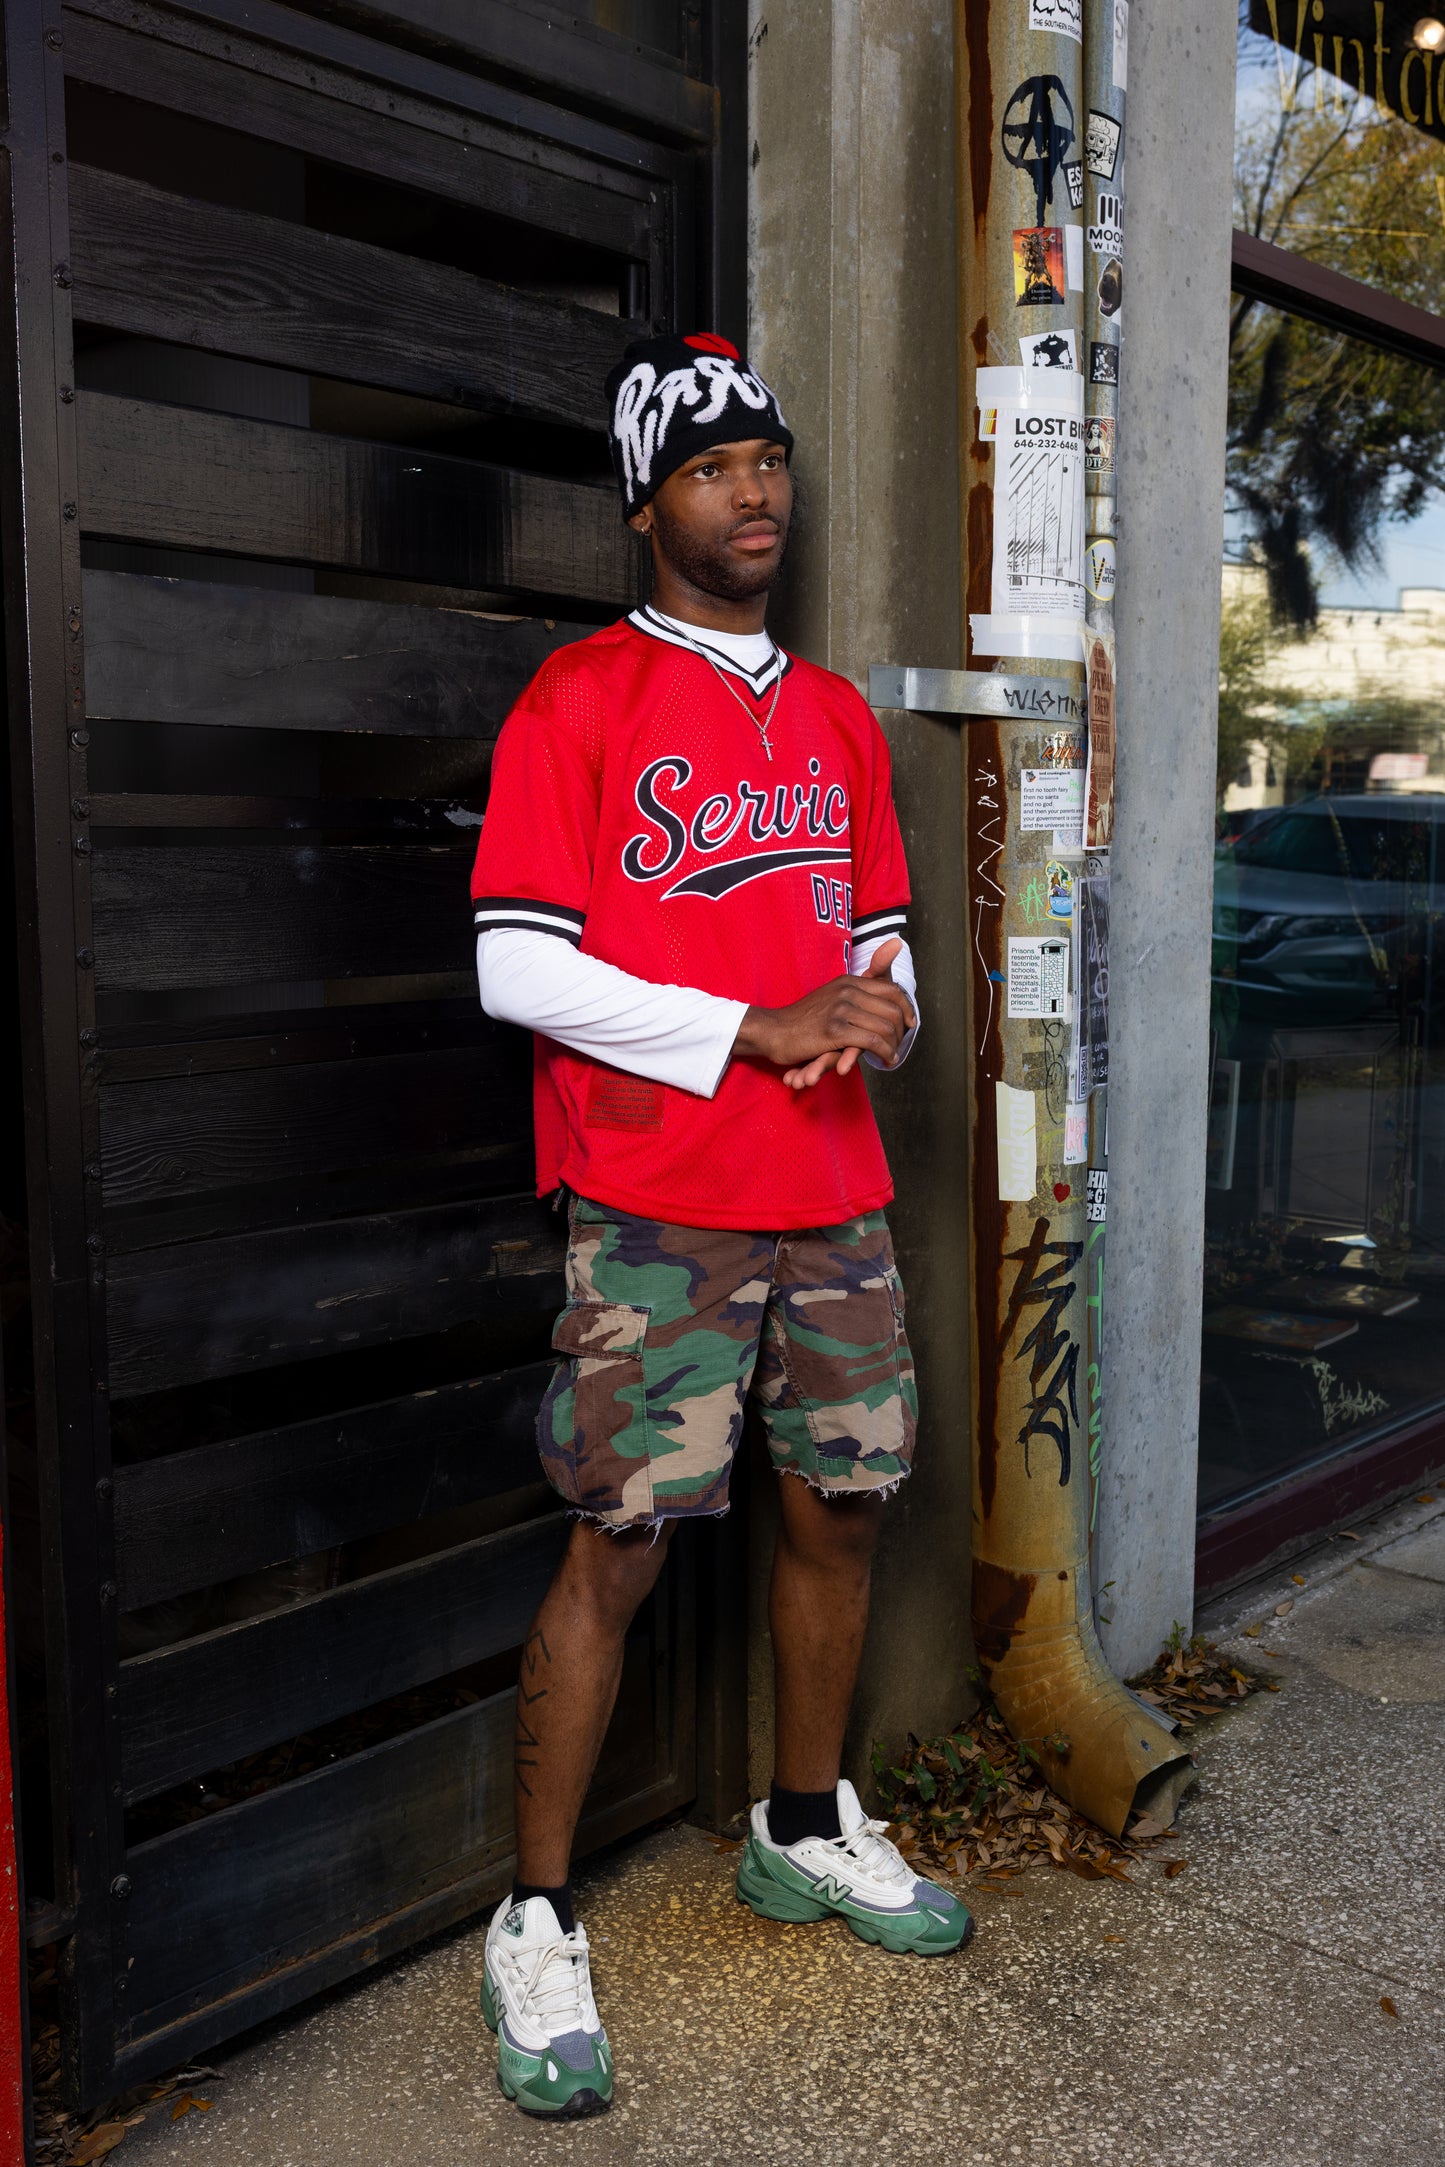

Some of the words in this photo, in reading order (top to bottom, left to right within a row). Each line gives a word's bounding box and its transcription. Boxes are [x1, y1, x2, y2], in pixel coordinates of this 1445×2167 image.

[1266, 0, 1445, 125] Vinta
[1014, 439, 1078, 451] 646-232-6468
[1015, 417, 1067, 436] LOST
[622, 755, 850, 882] Servic
